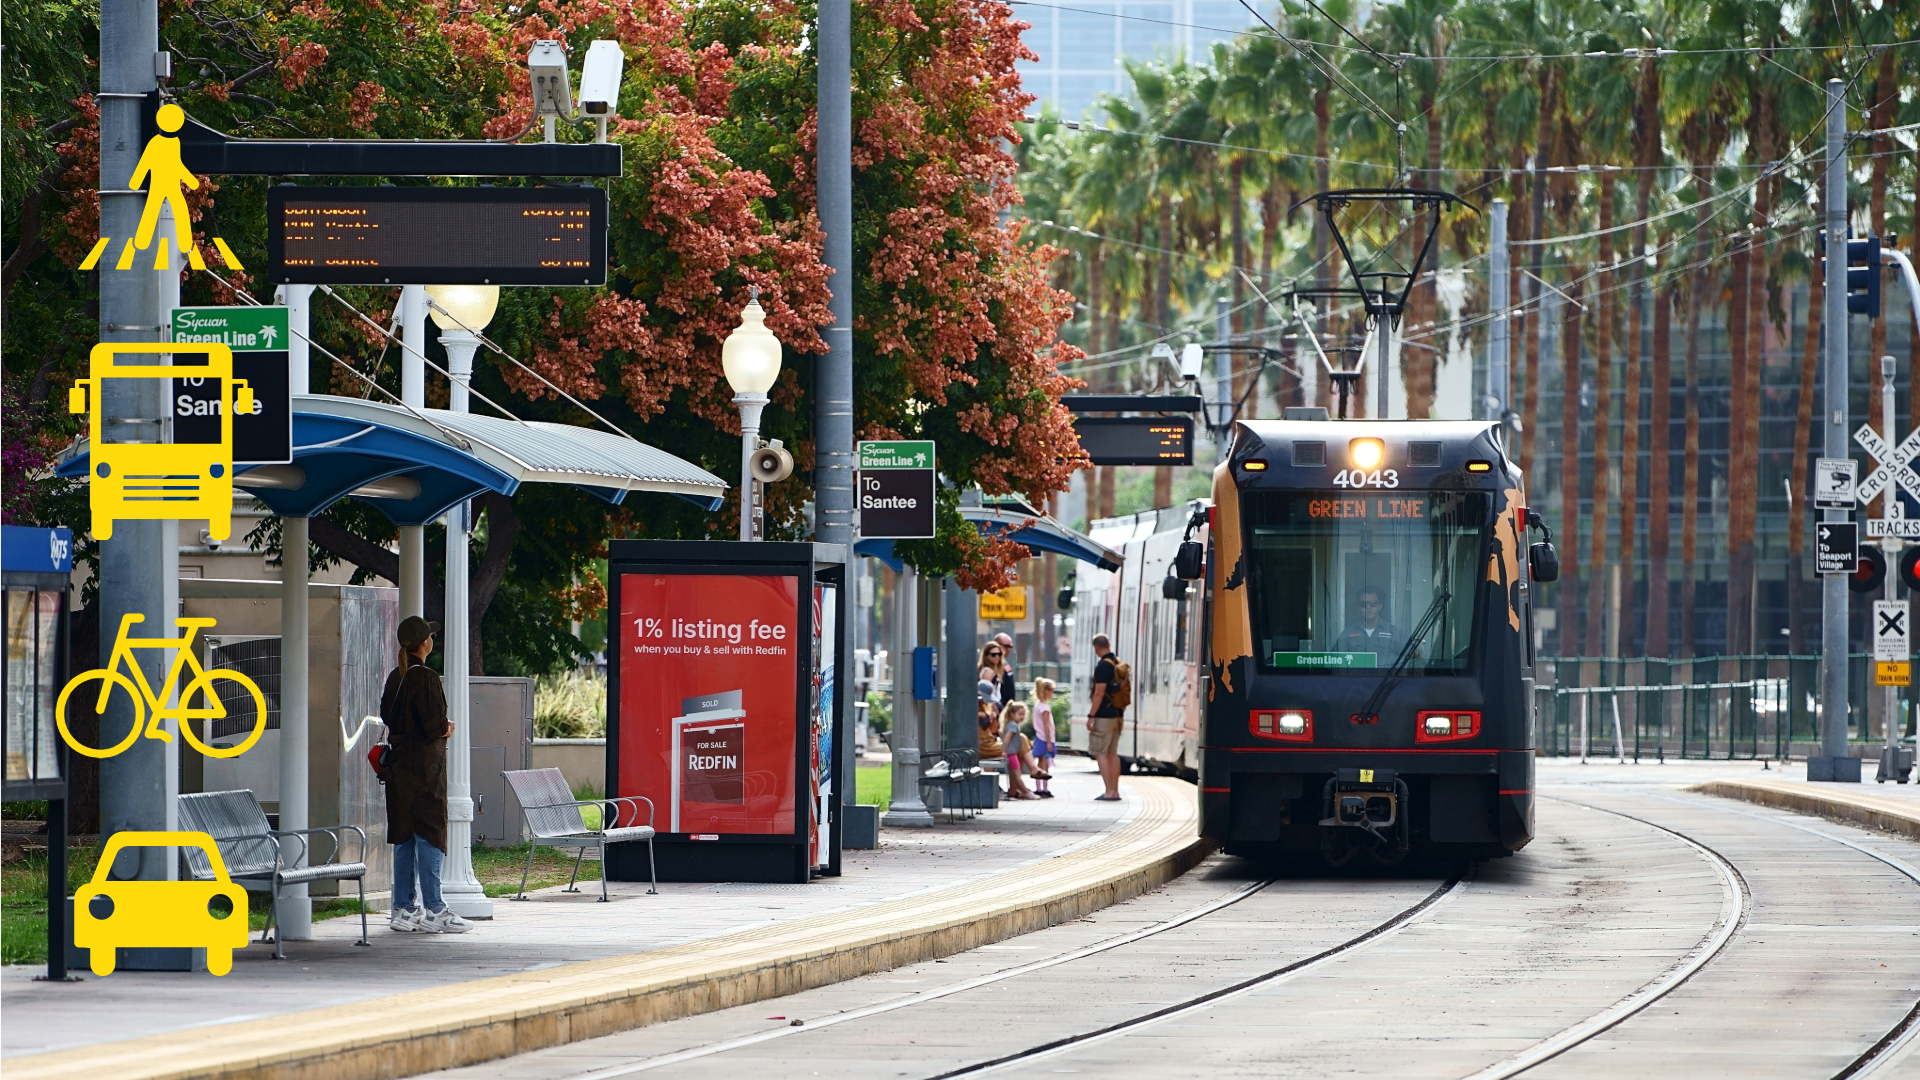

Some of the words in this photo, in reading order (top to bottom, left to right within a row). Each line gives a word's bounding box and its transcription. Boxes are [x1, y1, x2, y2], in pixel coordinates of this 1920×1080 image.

[176, 311, 229, 332] Sycuan
[175, 331, 222, 344] Green
[223, 331, 257, 346] Line
[177, 394, 263, 416] Sane
[862, 443, 896, 457] Sycuan
[862, 456, 891, 466] Green
[892, 456, 913, 466] Line
[862, 477, 881, 491] To
[1333, 469, 1399, 489] 4043
[862, 495, 917, 509] Santee
[1308, 499, 1367, 518] GREEN
[1377, 499, 1424, 518] LINE
[1891, 503, 1900, 519] 3
[1870, 521, 1920, 535] TRACKS
[1819, 543, 1830, 552] To
[1819, 552, 1852, 562] Seaport
[1819, 561, 1844, 571] Village
[633, 618, 663, 639] 1%
[672, 618, 742, 644] listing
[749, 619, 786, 640] fee
[634, 645, 661, 654] when
[663, 646, 681, 655] you
[683, 645, 702, 656] buy
[703, 646, 711, 654] &
[713, 645, 730, 655] sell
[732, 645, 753, 655] with
[755, 646, 787, 656] Redfin
[1296, 655, 1323, 665] Green
[1323, 655, 1343, 665] Line
[1887, 665, 1898, 673] NO
[701, 699, 719, 708] SOLD
[710, 741, 727, 749] SALE
[688, 754, 737, 771] REDFIN
